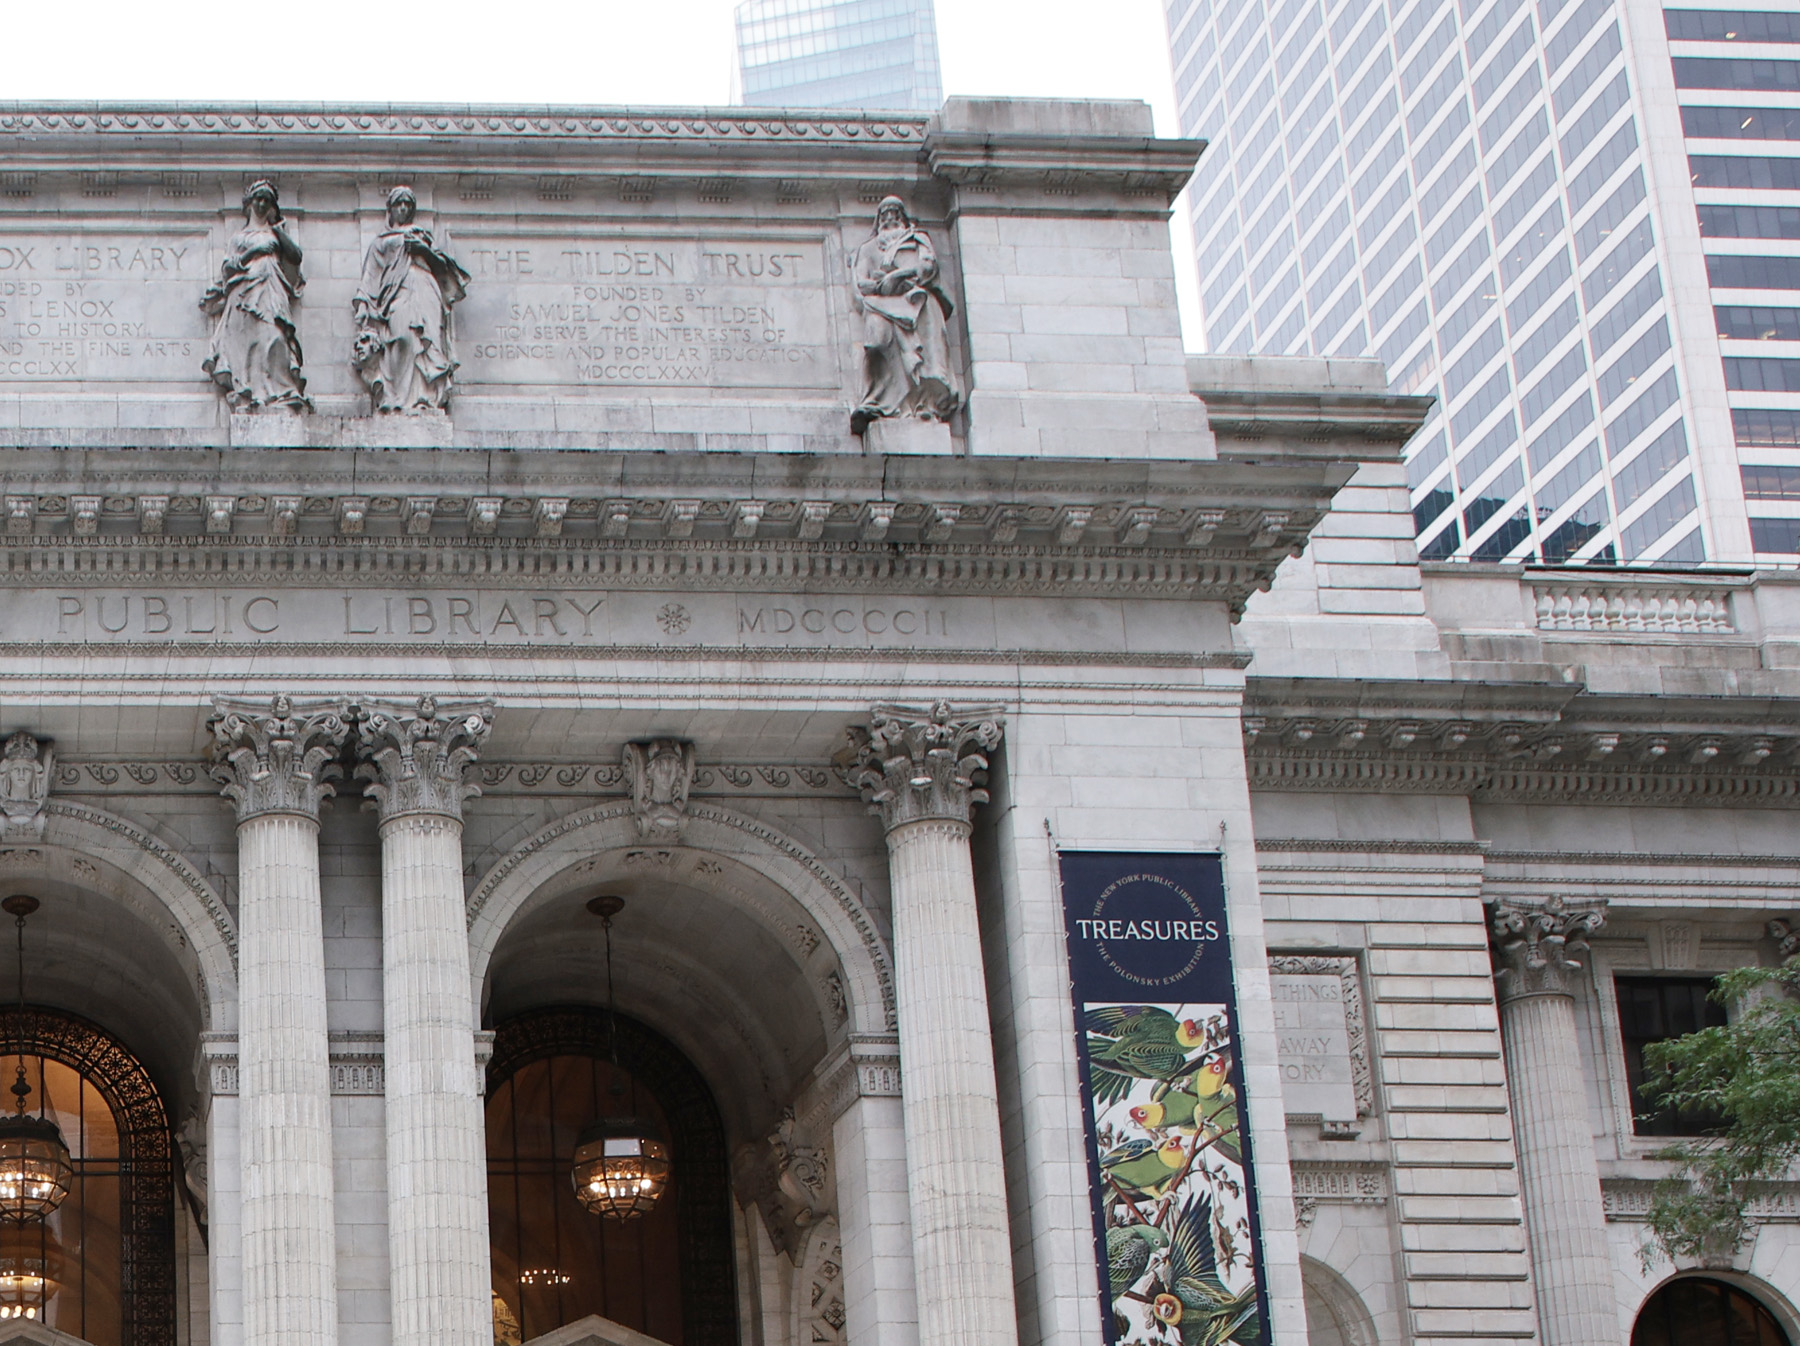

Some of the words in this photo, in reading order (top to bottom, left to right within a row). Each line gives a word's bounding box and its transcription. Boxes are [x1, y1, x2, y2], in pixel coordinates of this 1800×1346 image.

[55, 247, 188, 271] LIBRARY
[472, 250, 533, 274] THE
[561, 252, 675, 276] TILDEN
[702, 253, 804, 278] TRUST
[66, 283, 87, 296] BY
[573, 287, 663, 301] FOUNDED
[686, 288, 706, 301] BY
[30, 301, 114, 317] LENOX
[509, 304, 600, 322] SAMUEL
[610, 306, 684, 323] JONES
[696, 307, 775, 324] TILDEN
[14, 323, 40, 336] TO
[496, 325, 521, 340] TO
[533, 327, 588, 341] SERVE
[601, 327, 639, 341] THE
[650, 328, 752, 343] INTERESTS
[762, 329, 785, 343] OF
[38, 342, 75, 356] THE
[89, 342, 131, 356] FINE
[142, 342, 191, 356] ARTS
[474, 345, 555, 360] SCIENCE
[566, 345, 604, 360] AND
[615, 347, 699, 361] POPULAR
[711, 347, 815, 363] EDUCATION
[56, 596, 280, 635] PUBLIC
[342, 597, 606, 636] LIBRARY
[737, 608, 950, 637] MDCCCCII
[1093, 899, 1105, 916] THE
[1100, 882, 1117, 900] NEW
[1115, 873, 1141, 887] YORK
[1142, 873, 1175, 889] PUBLIC
[1174, 884, 1203, 918] LIBRARY
[1075, 919, 1220, 941] TREASURES
[1096, 941, 1111, 961] THE
[1108, 960, 1160, 986] POLONSKY
[1162, 943, 1205, 985] EXHIBITION
[1279, 984, 1338, 1000] THINGS
